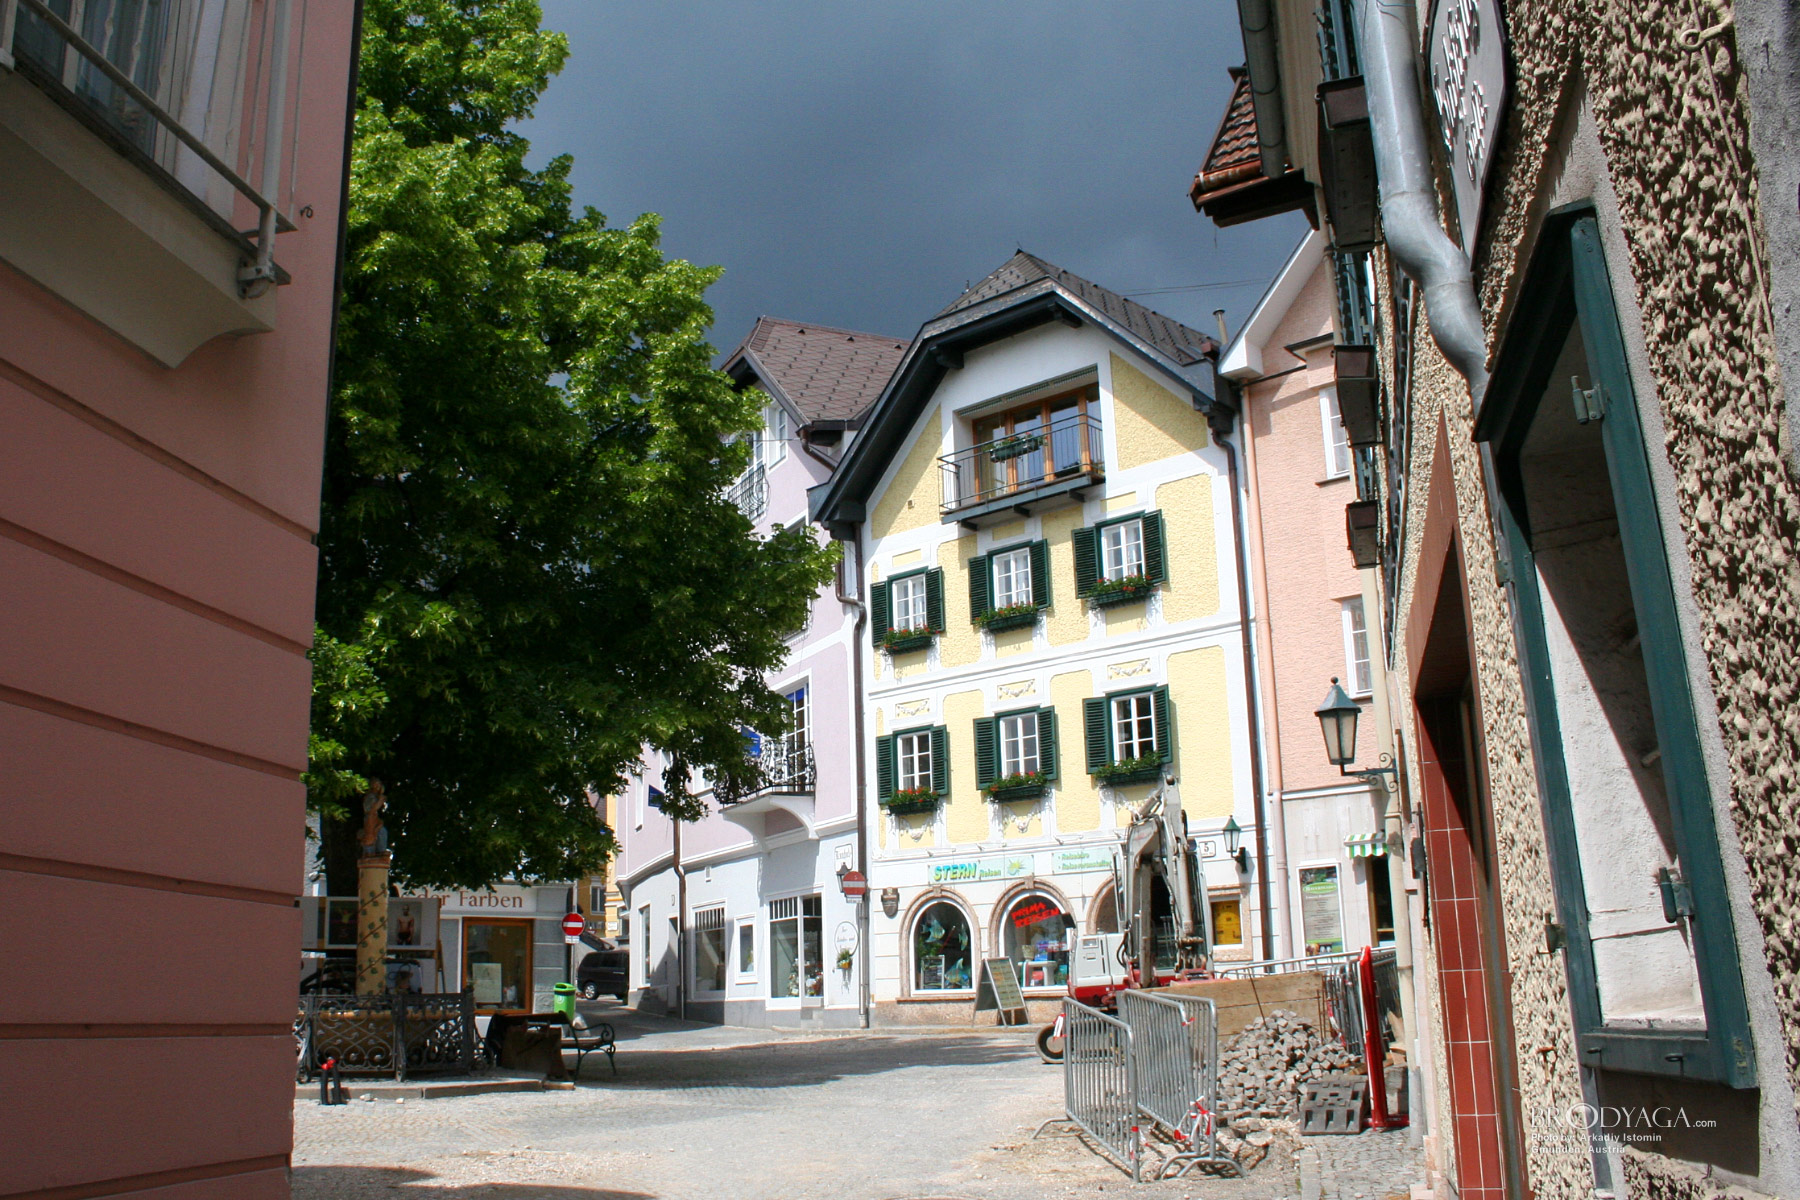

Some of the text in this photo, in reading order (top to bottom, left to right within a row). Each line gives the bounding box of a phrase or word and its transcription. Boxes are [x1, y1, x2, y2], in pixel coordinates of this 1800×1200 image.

[934, 863, 977, 881] STERN
[458, 889, 523, 908] Farben
[1011, 902, 1047, 920] PRIMA
[1014, 907, 1059, 928] REISEN
